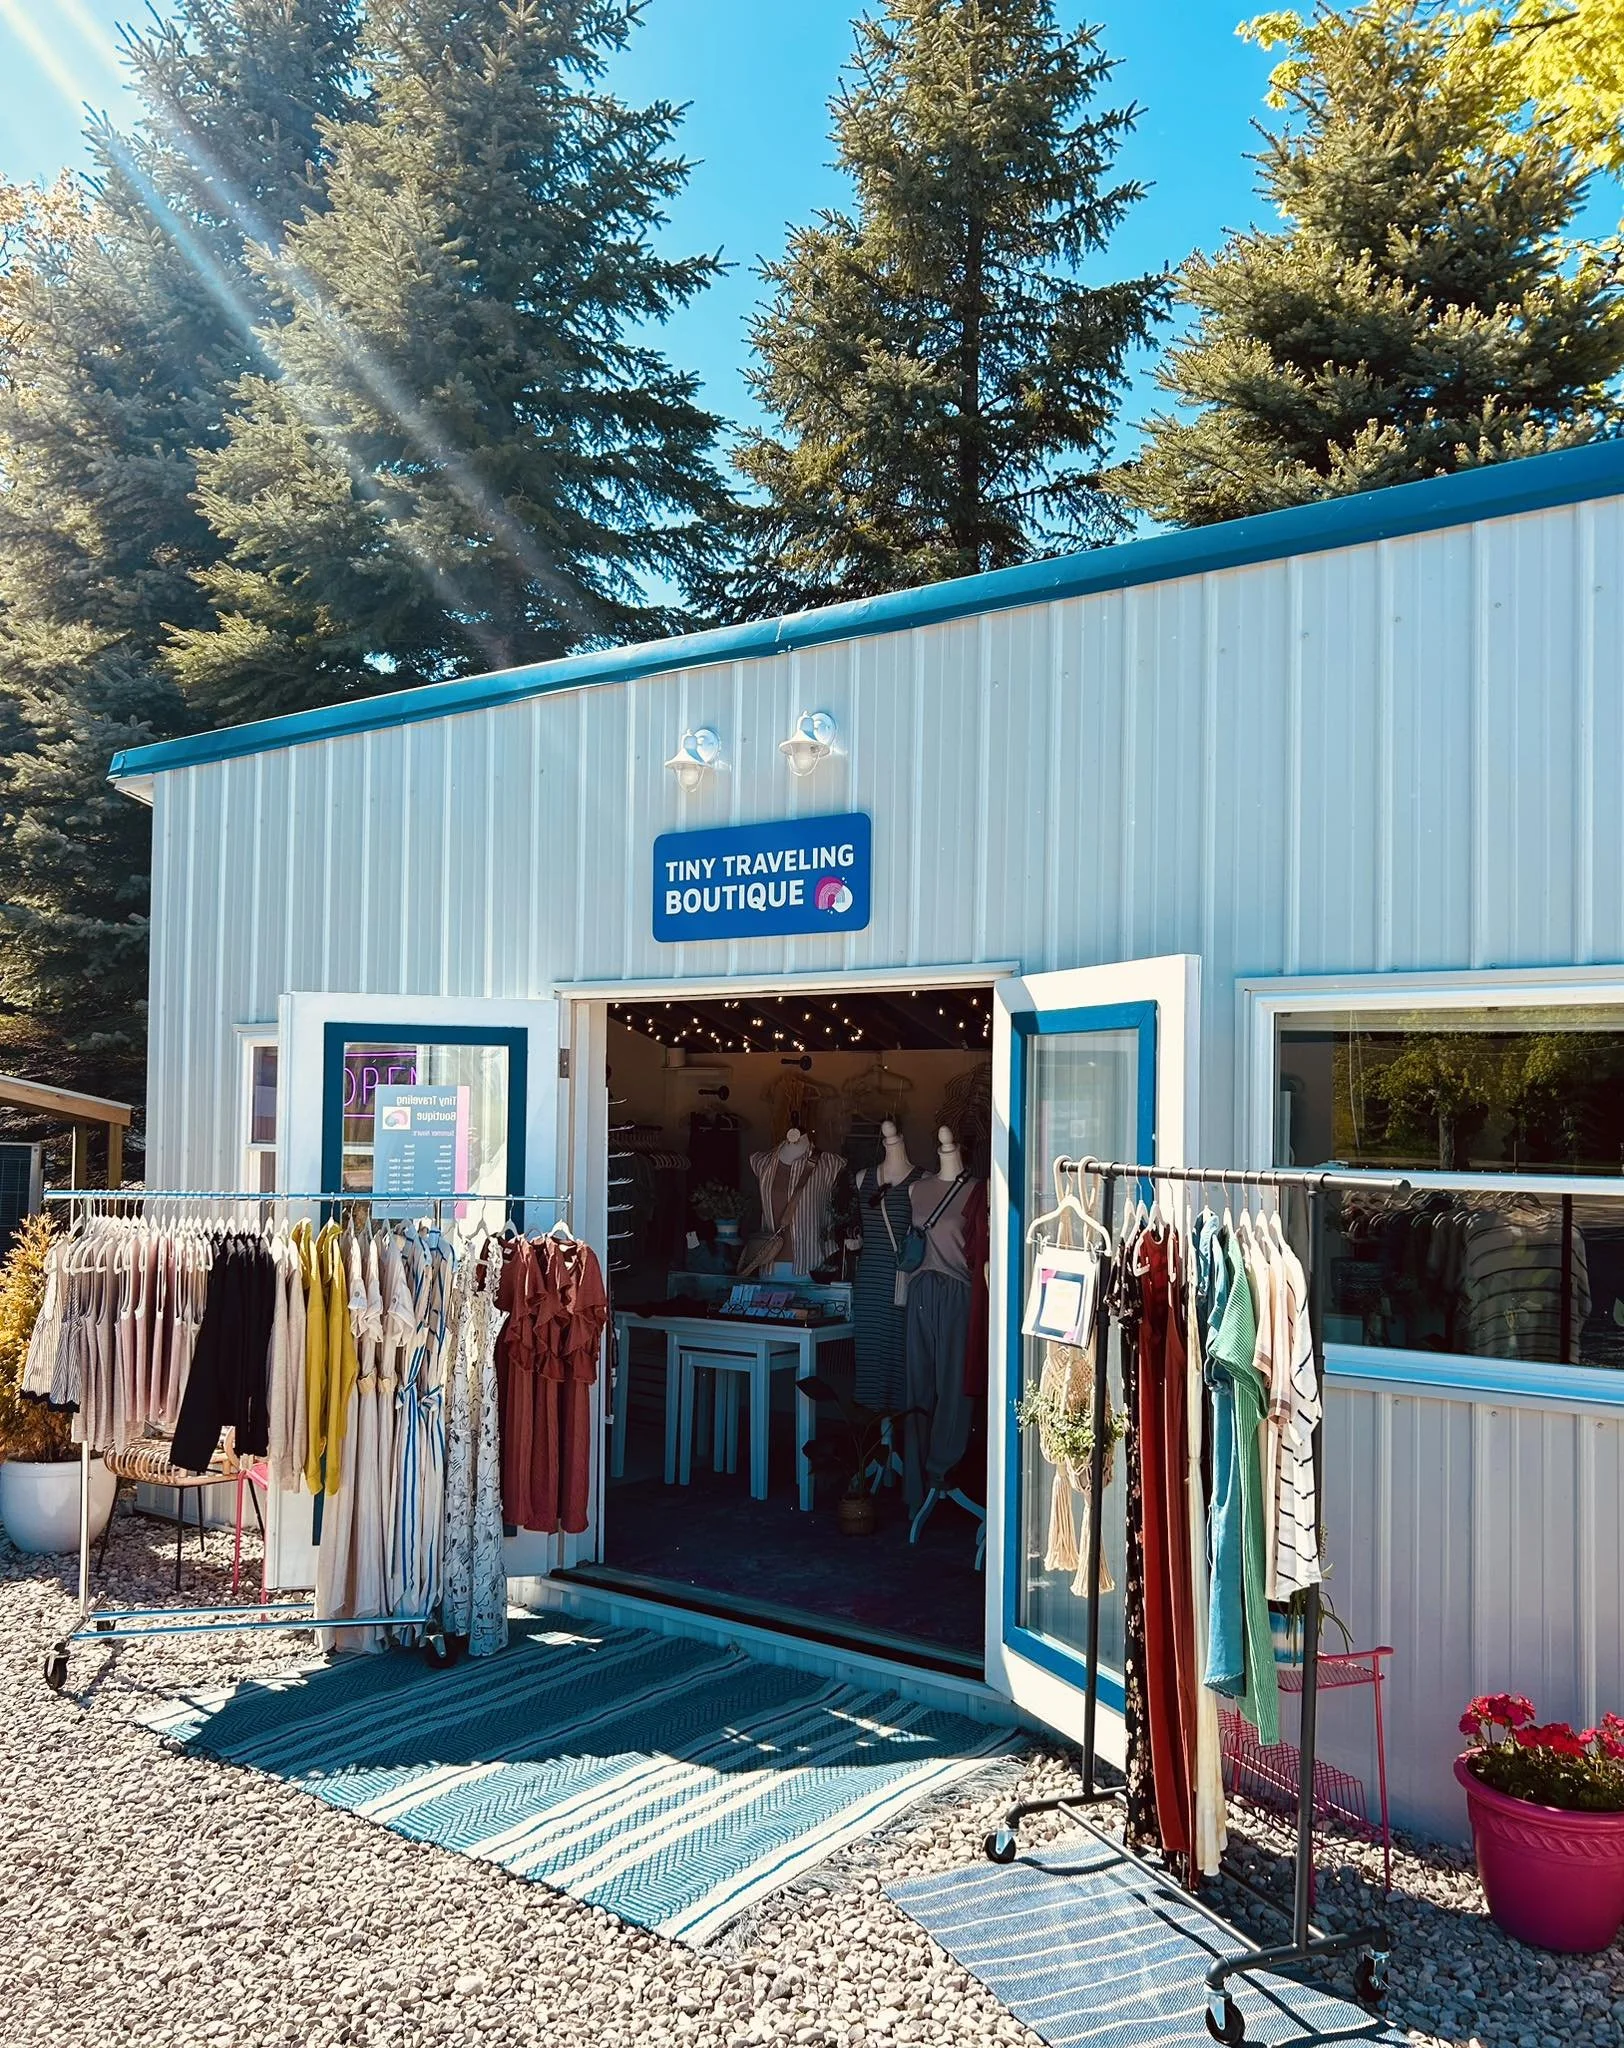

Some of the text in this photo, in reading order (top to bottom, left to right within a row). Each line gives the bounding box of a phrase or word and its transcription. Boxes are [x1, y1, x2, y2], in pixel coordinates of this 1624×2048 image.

[665, 844, 854, 882] TINY TRAVELING
[665, 879, 804, 915] BOUTIQUE
[343, 1066, 417, 1107] OPE
